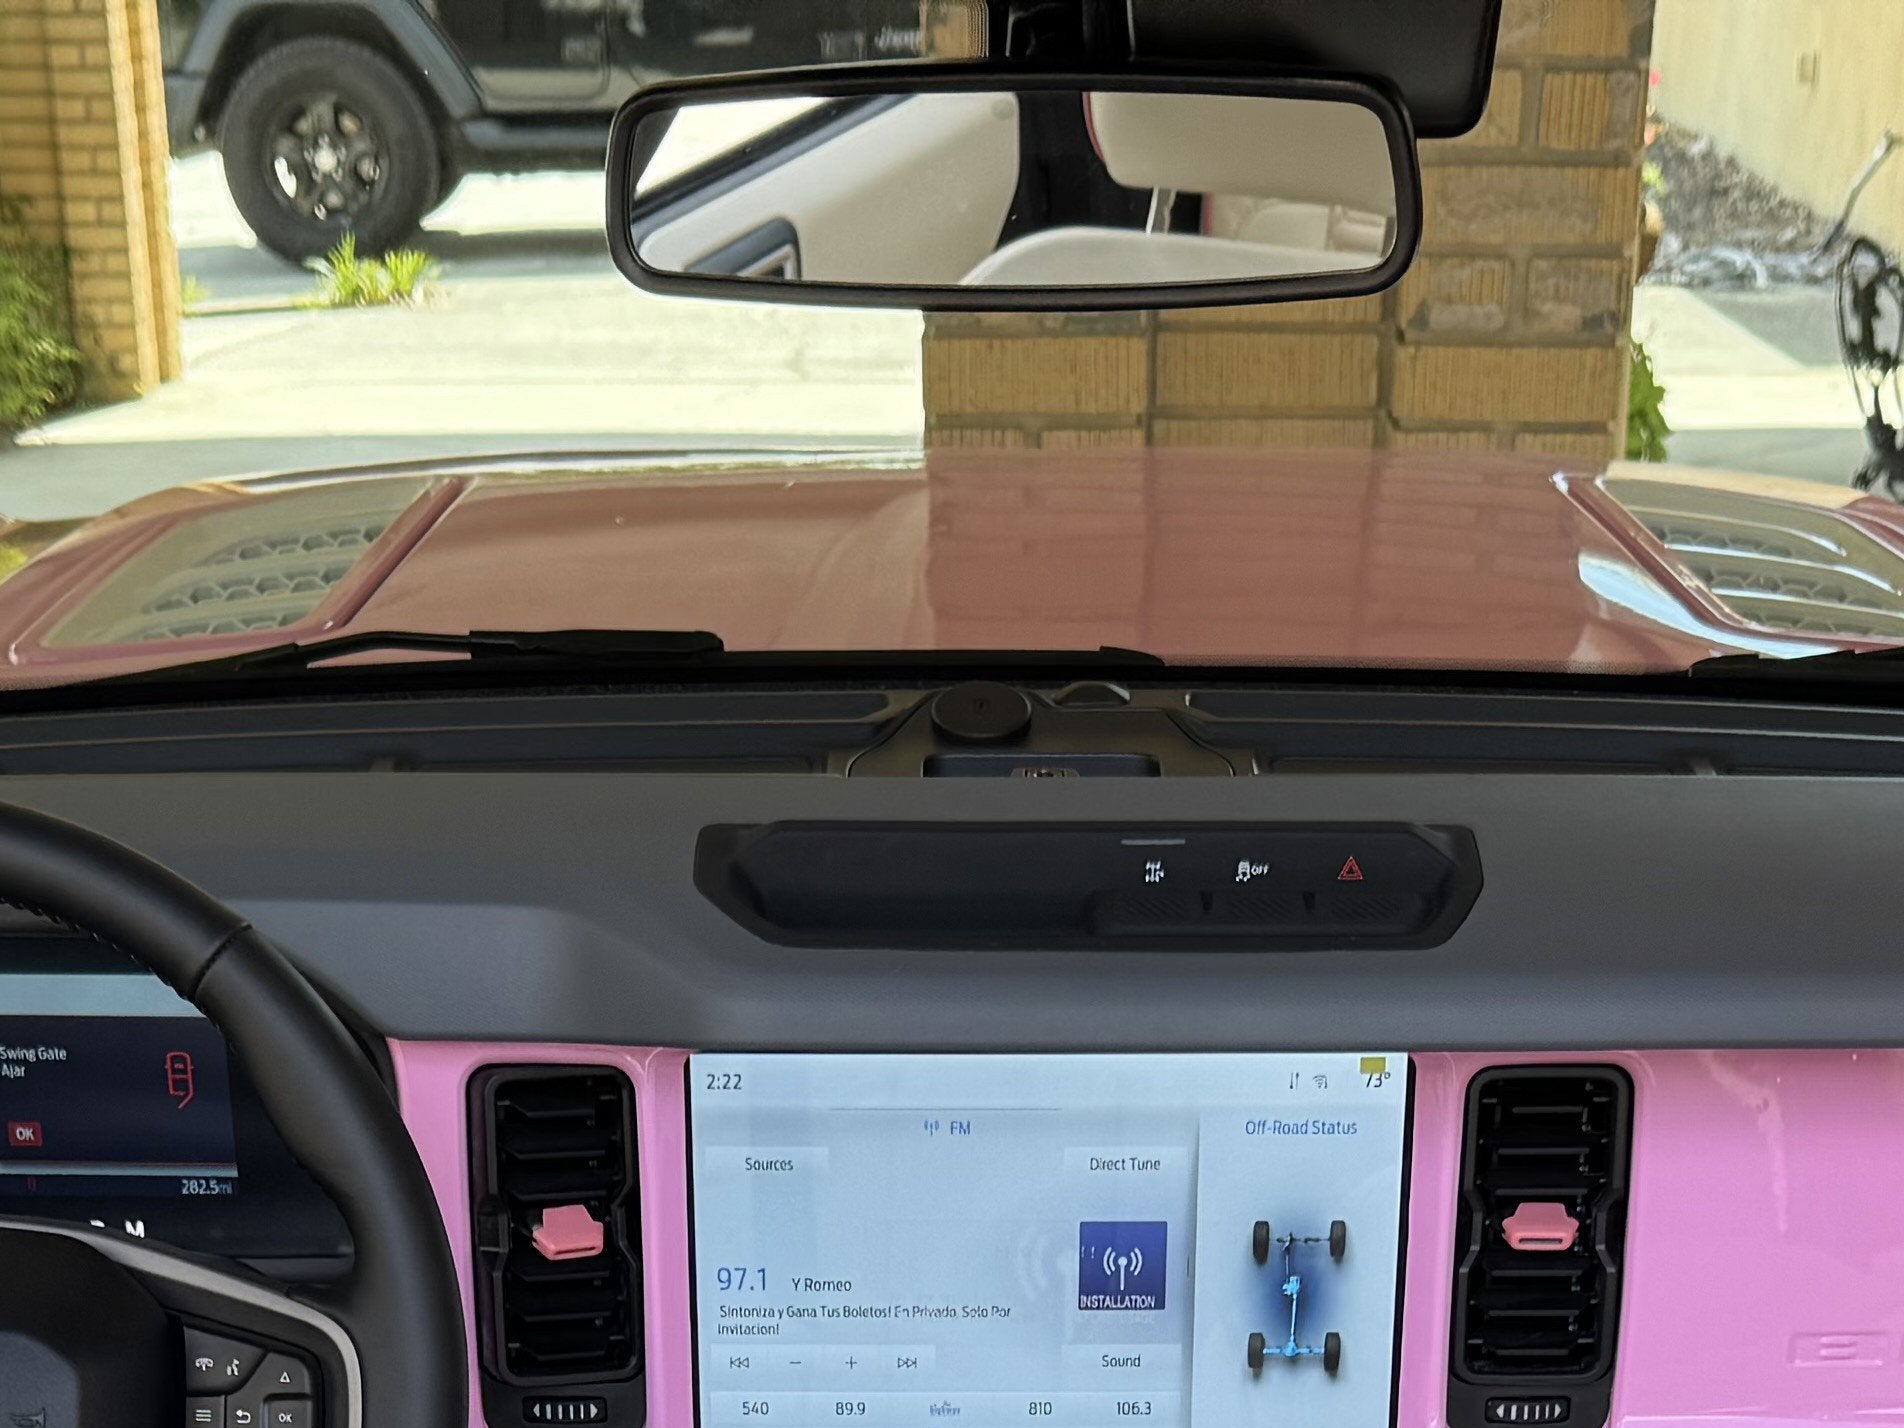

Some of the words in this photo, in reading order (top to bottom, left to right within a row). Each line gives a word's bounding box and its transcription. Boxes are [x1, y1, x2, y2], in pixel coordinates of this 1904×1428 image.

[37, 1046, 68, 1061] Gate
[0, 1063, 27, 1079] Ajar
[706, 1073, 743, 1090] 2:22
[15, 1126, 35, 1141] OK
[950, 1120, 971, 1135] FM
[1245, 1120, 1309, 1136] Off-Road
[1311, 1120, 1358, 1136] Status
[744, 1156, 794, 1172] Sources
[1089, 1157, 1126, 1171] Direct
[1129, 1157, 1161, 1171] Tune
[716, 1267, 768, 1292] 97.1
[792, 1277, 802, 1292] Y
[804, 1277, 852, 1292] Romeo
[1079, 1295, 1156, 1309] INSTALLATION
[719, 1304, 775, 1318] Sintoniza
[778, 1308, 785, 1321] y
[786, 1305, 817, 1318] Gana
[820, 1305, 841, 1318] Tus
[843, 1305, 891, 1319] Boletos!
[894, 1305, 910, 1318] En
[962, 1305, 988, 1318] Solo
[992, 1305, 1012, 1318] Por
[717, 1322, 780, 1336] Invitacion!
[1101, 1354, 1141, 1368] Sound
[741, 1401, 770, 1416] 540
[834, 1401, 866, 1416] 89.9
[1028, 1401, 1052, 1416] 810
[1116, 1401, 1152, 1416] 106.3
[278, 1412, 293, 1423] OK
